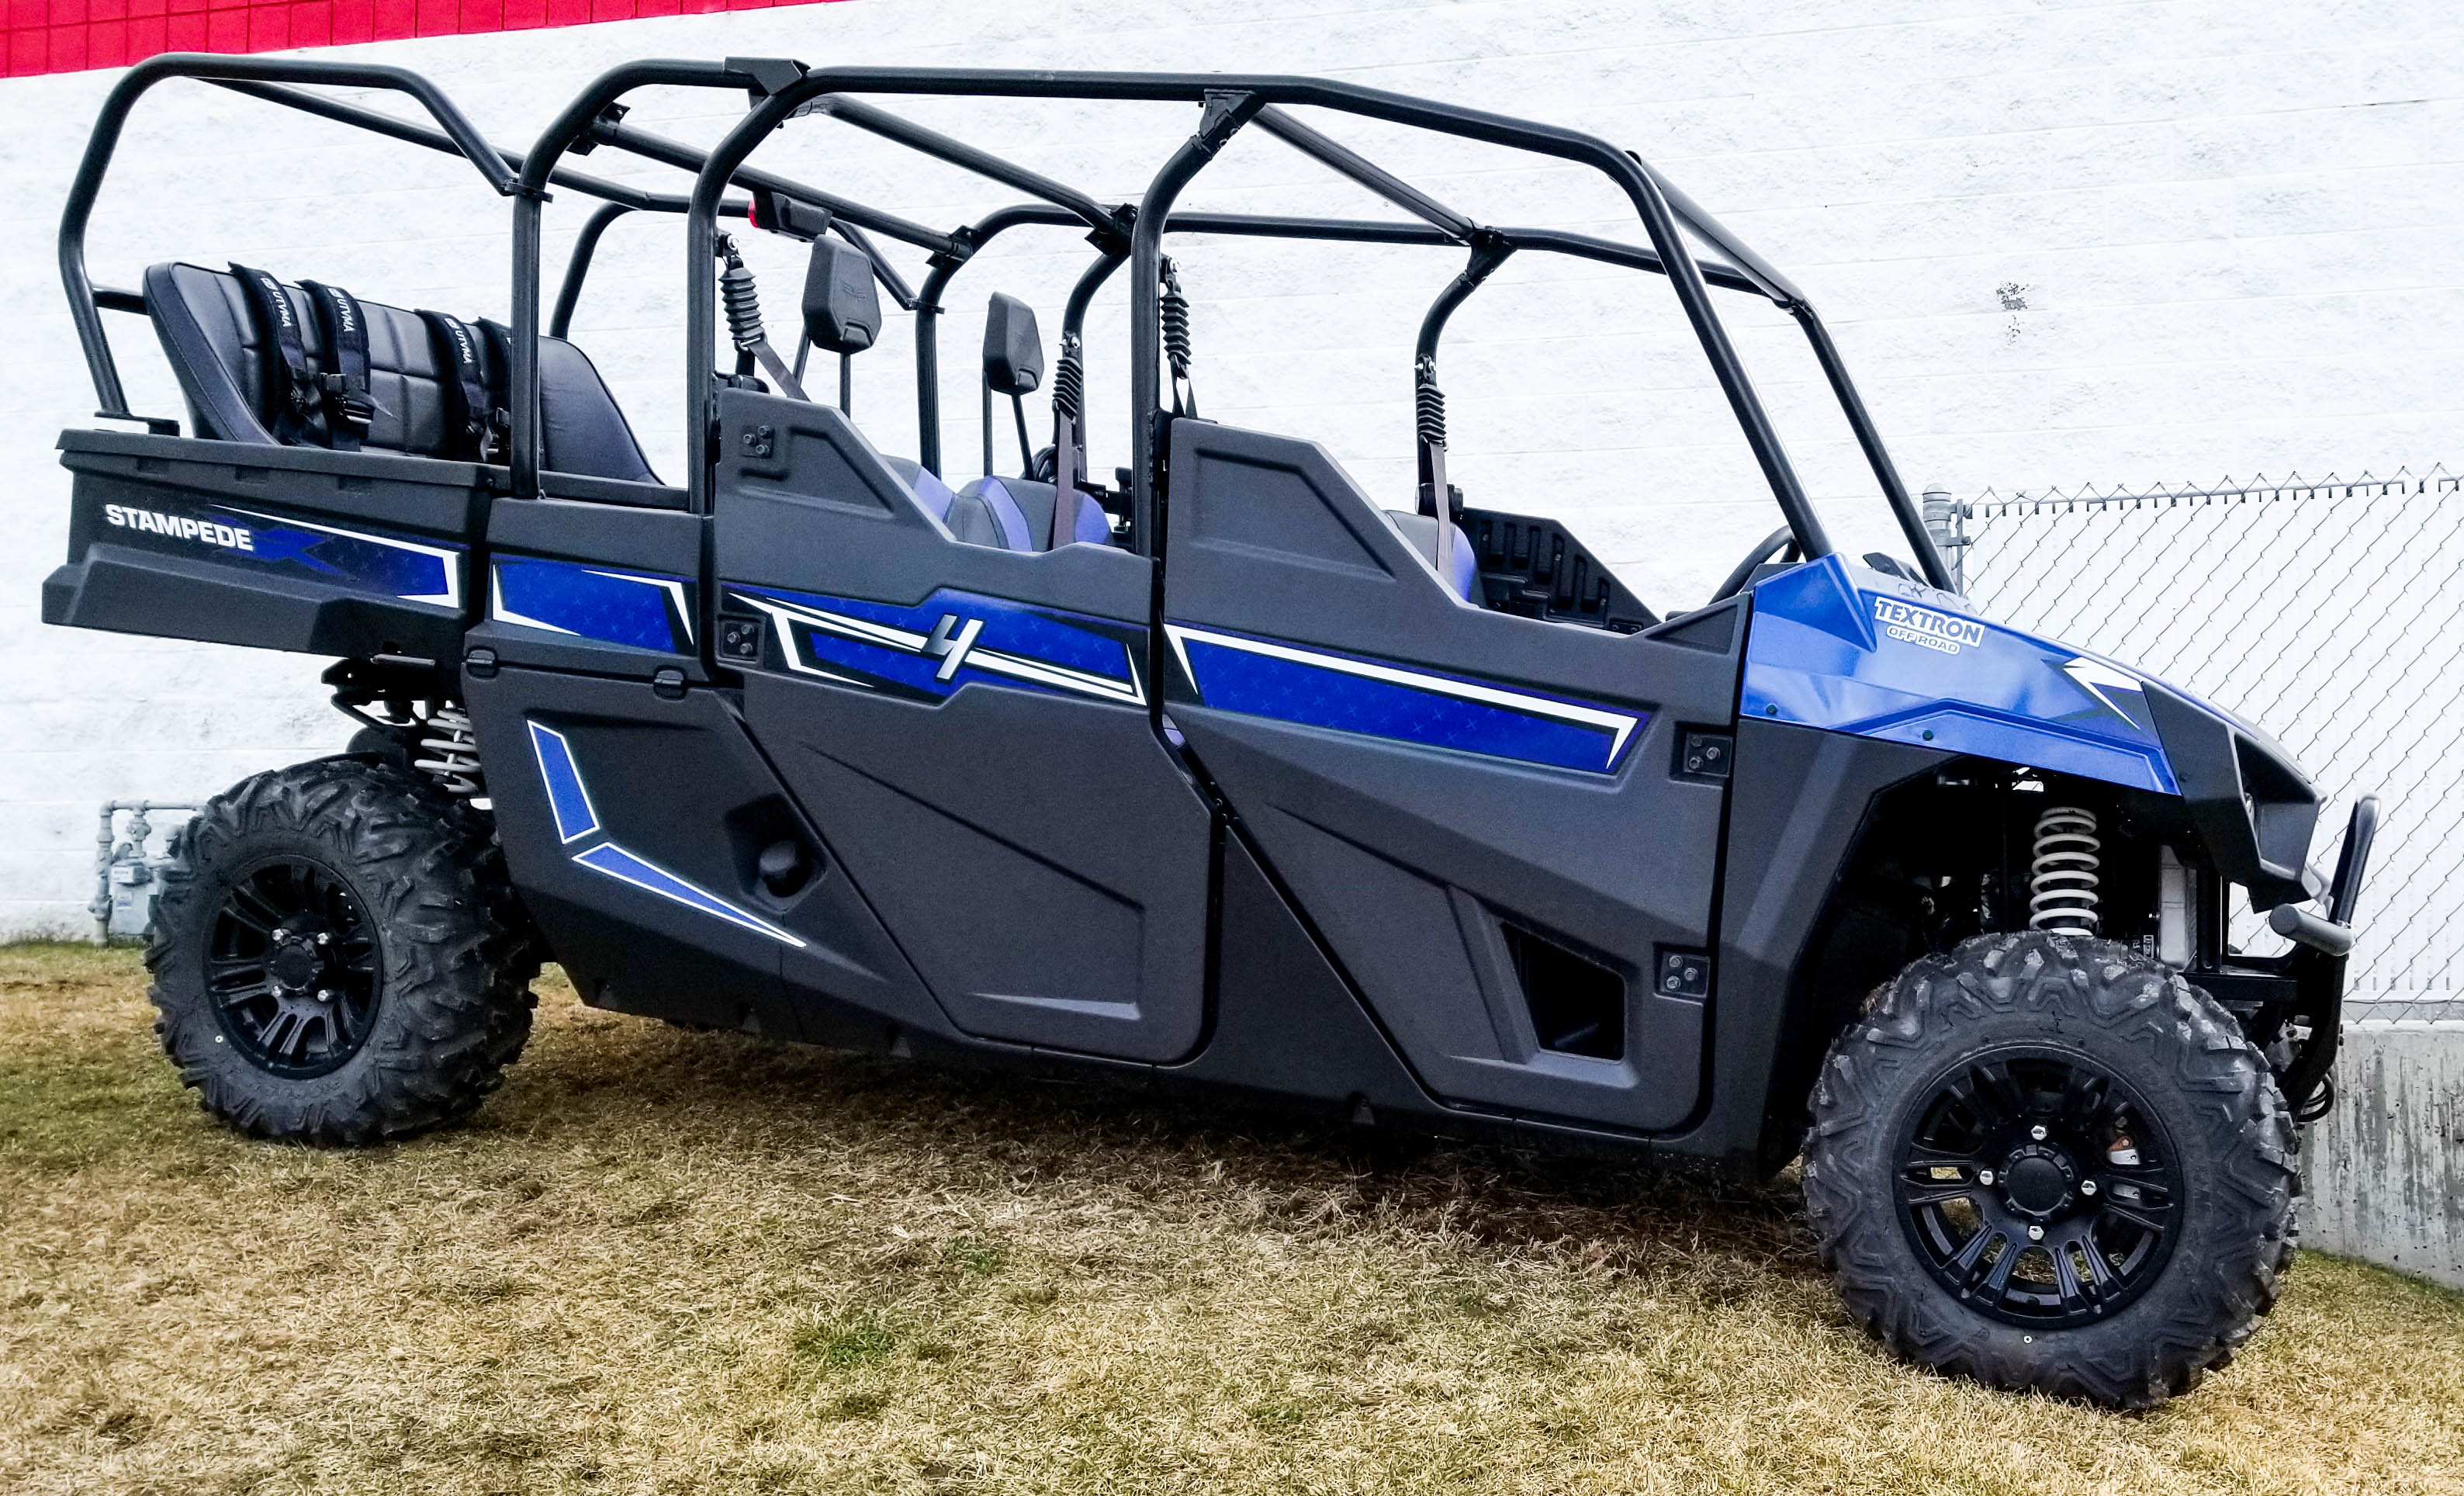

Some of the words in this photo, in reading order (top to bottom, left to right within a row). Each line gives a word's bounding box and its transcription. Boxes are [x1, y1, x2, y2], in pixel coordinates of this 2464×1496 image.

[272, 292, 292, 327] UTVMA
[337, 299, 355, 332] UTVMA
[455, 331, 472, 363] UTVMA
[106, 504, 254, 552] STAMPEDE
[1878, 601, 1981, 642] TEXTRON
[923, 614, 984, 680] 4
[1888, 627, 1916, 640] OFF
[1919, 637, 1958, 653] ROAD
